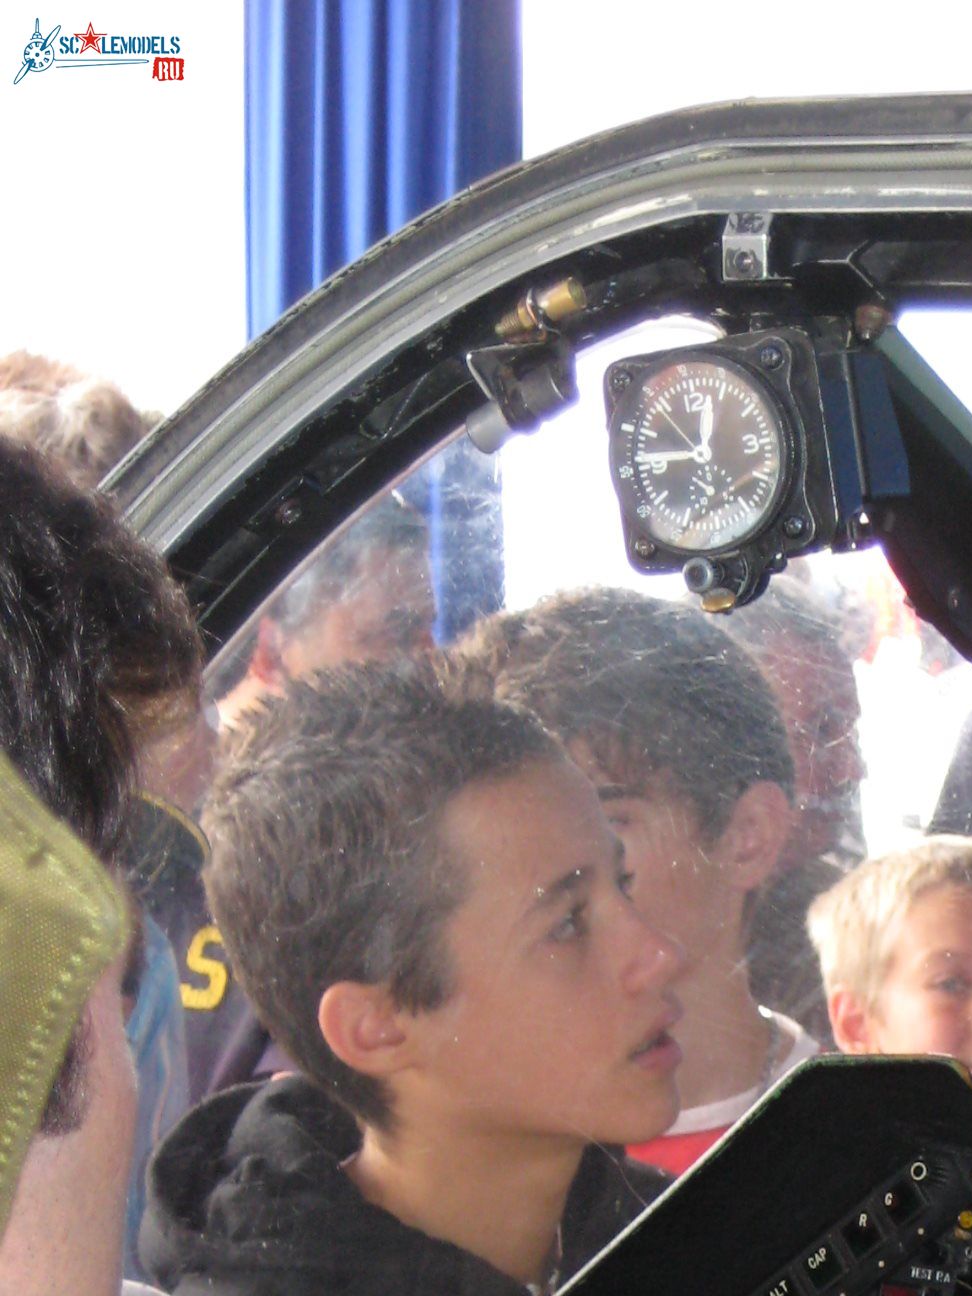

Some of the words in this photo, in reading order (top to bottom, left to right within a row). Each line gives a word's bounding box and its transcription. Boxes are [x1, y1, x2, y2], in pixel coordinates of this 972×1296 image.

[684, 393, 706, 413] 12
[742, 433, 760, 455] 3
[884, 1191, 894, 1207] G
[859, 1212, 868, 1228] R
[807, 1247, 828, 1270] CAP
[910, 1266, 933, 1283] TEST
